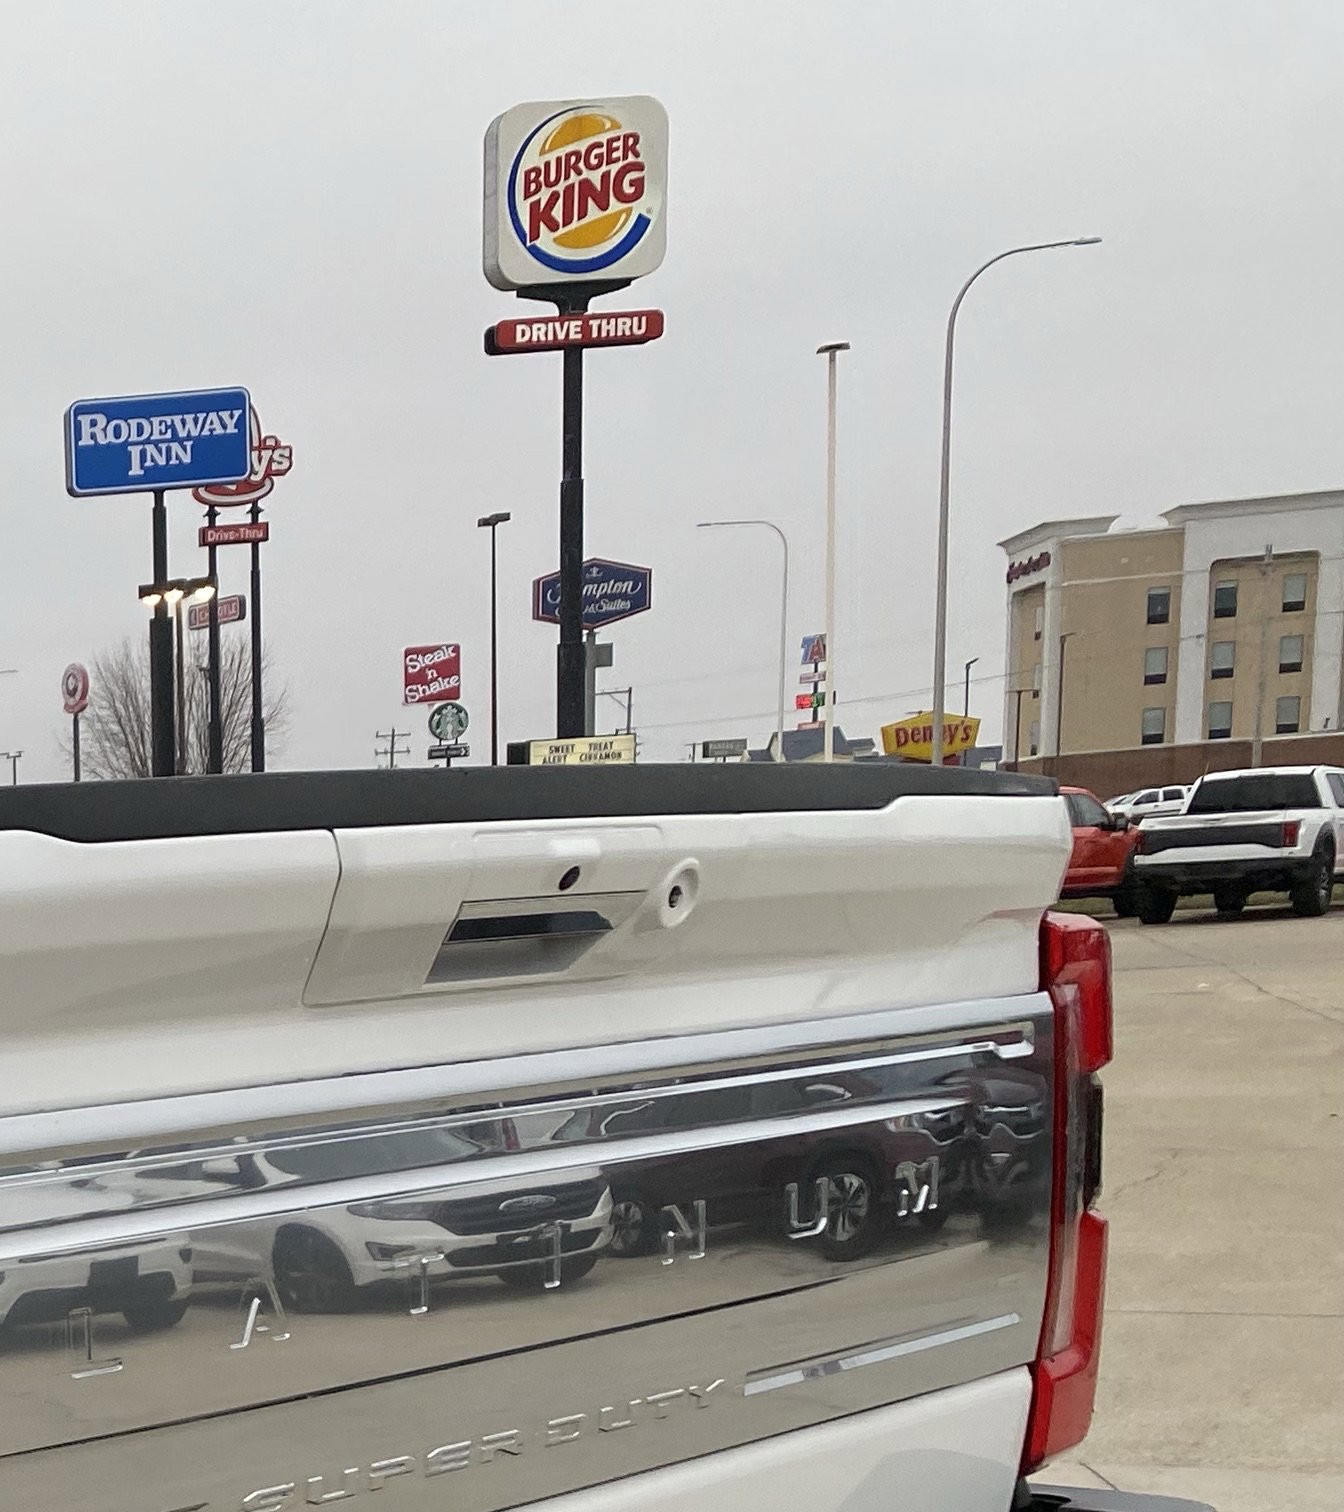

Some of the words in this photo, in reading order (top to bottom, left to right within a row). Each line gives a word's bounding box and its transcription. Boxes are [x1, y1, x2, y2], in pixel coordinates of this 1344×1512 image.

[523, 131, 641, 201] BURGER
[527, 161, 646, 244] KING
[515, 319, 583, 343] DRIVE
[588, 315, 647, 338] THRU
[77, 409, 243, 446] RODEWAY
[128, 441, 193, 476] INN
[406, 645, 456, 673] Steak
[405, 675, 460, 703] Shake
[895, 720, 973, 748] Deny's
[544, 1378, 725, 1448] DUTY
